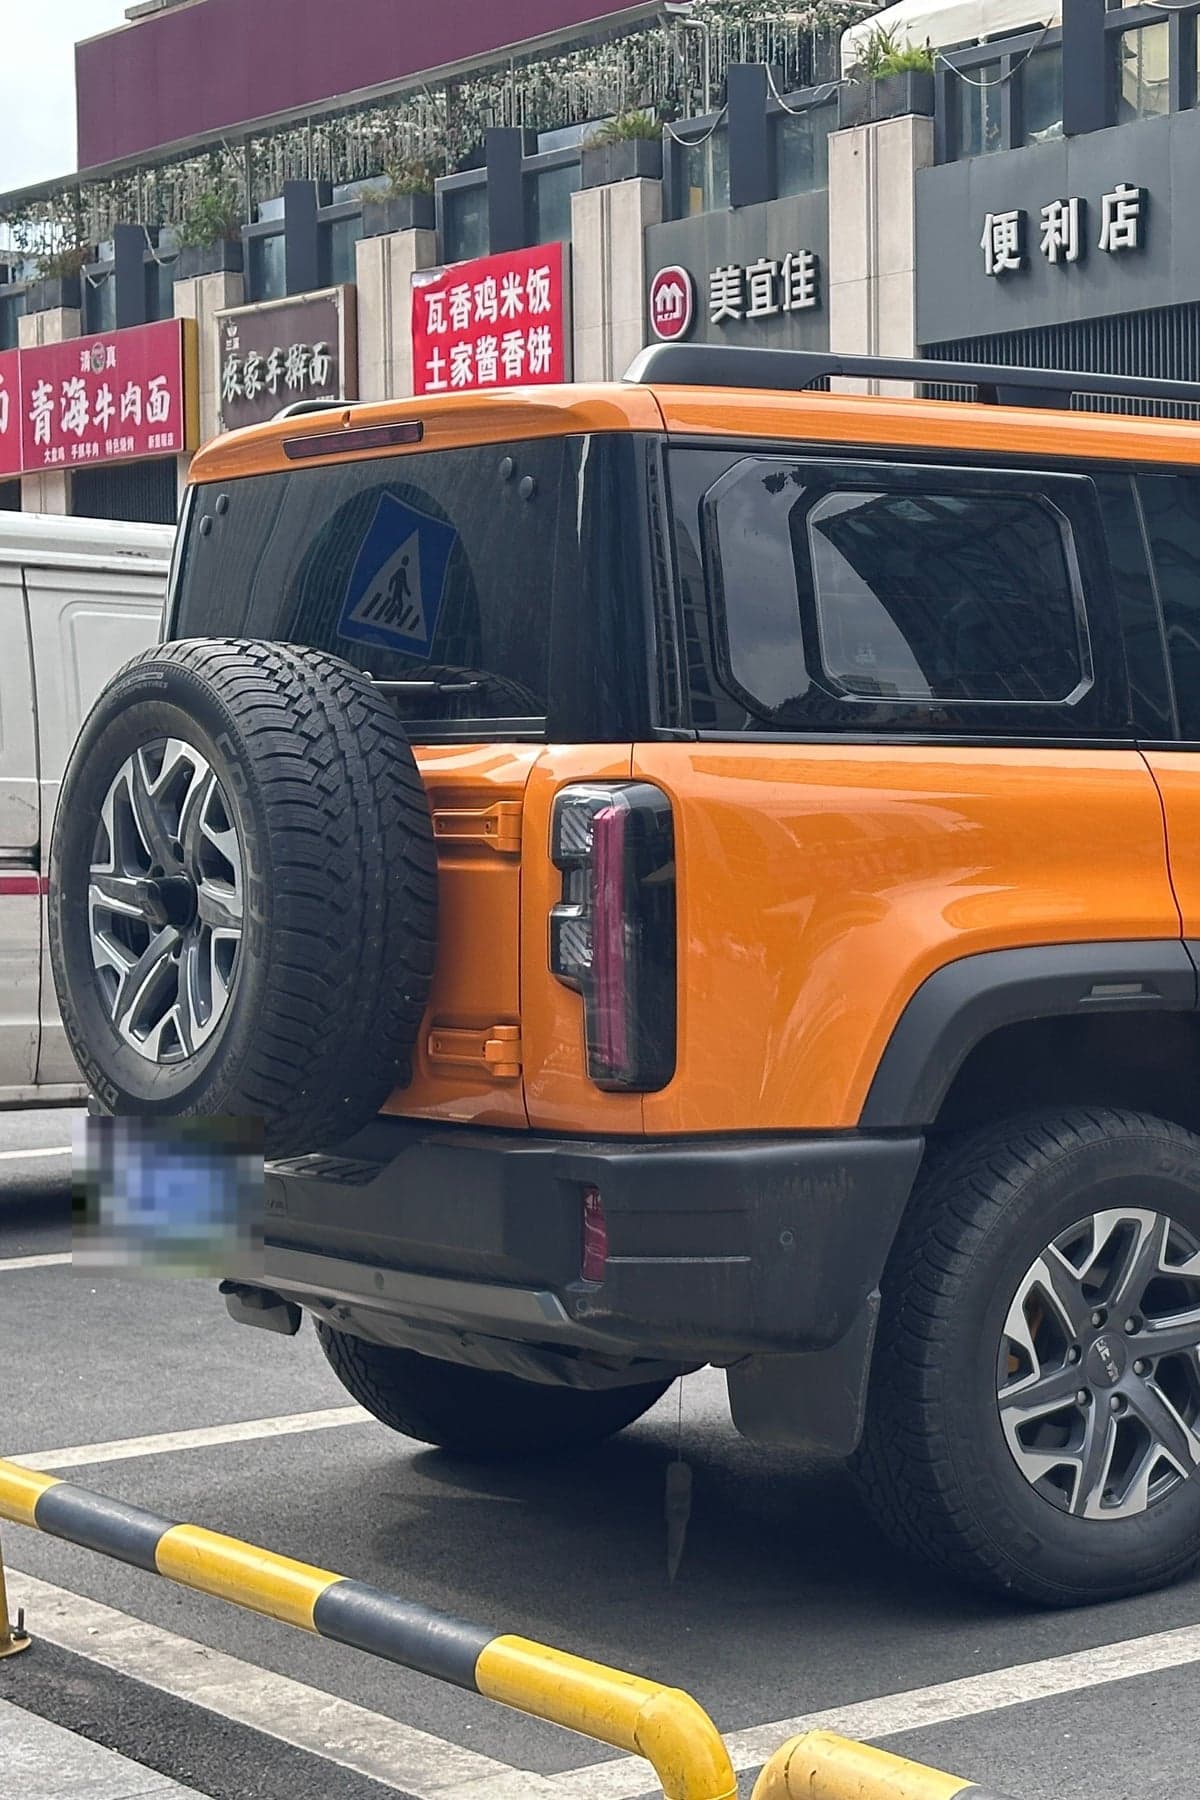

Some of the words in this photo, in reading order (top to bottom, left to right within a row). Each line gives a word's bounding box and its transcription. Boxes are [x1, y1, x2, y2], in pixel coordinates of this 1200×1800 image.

[980, 183, 1141, 277] 便利店
[424, 265, 551, 335] 瓦香鸡米饭
[709, 250, 816, 323] 美宜佳
[425, 325, 552, 391] 土家酱香饼
[29, 375, 171, 445] 青海牛肉面
